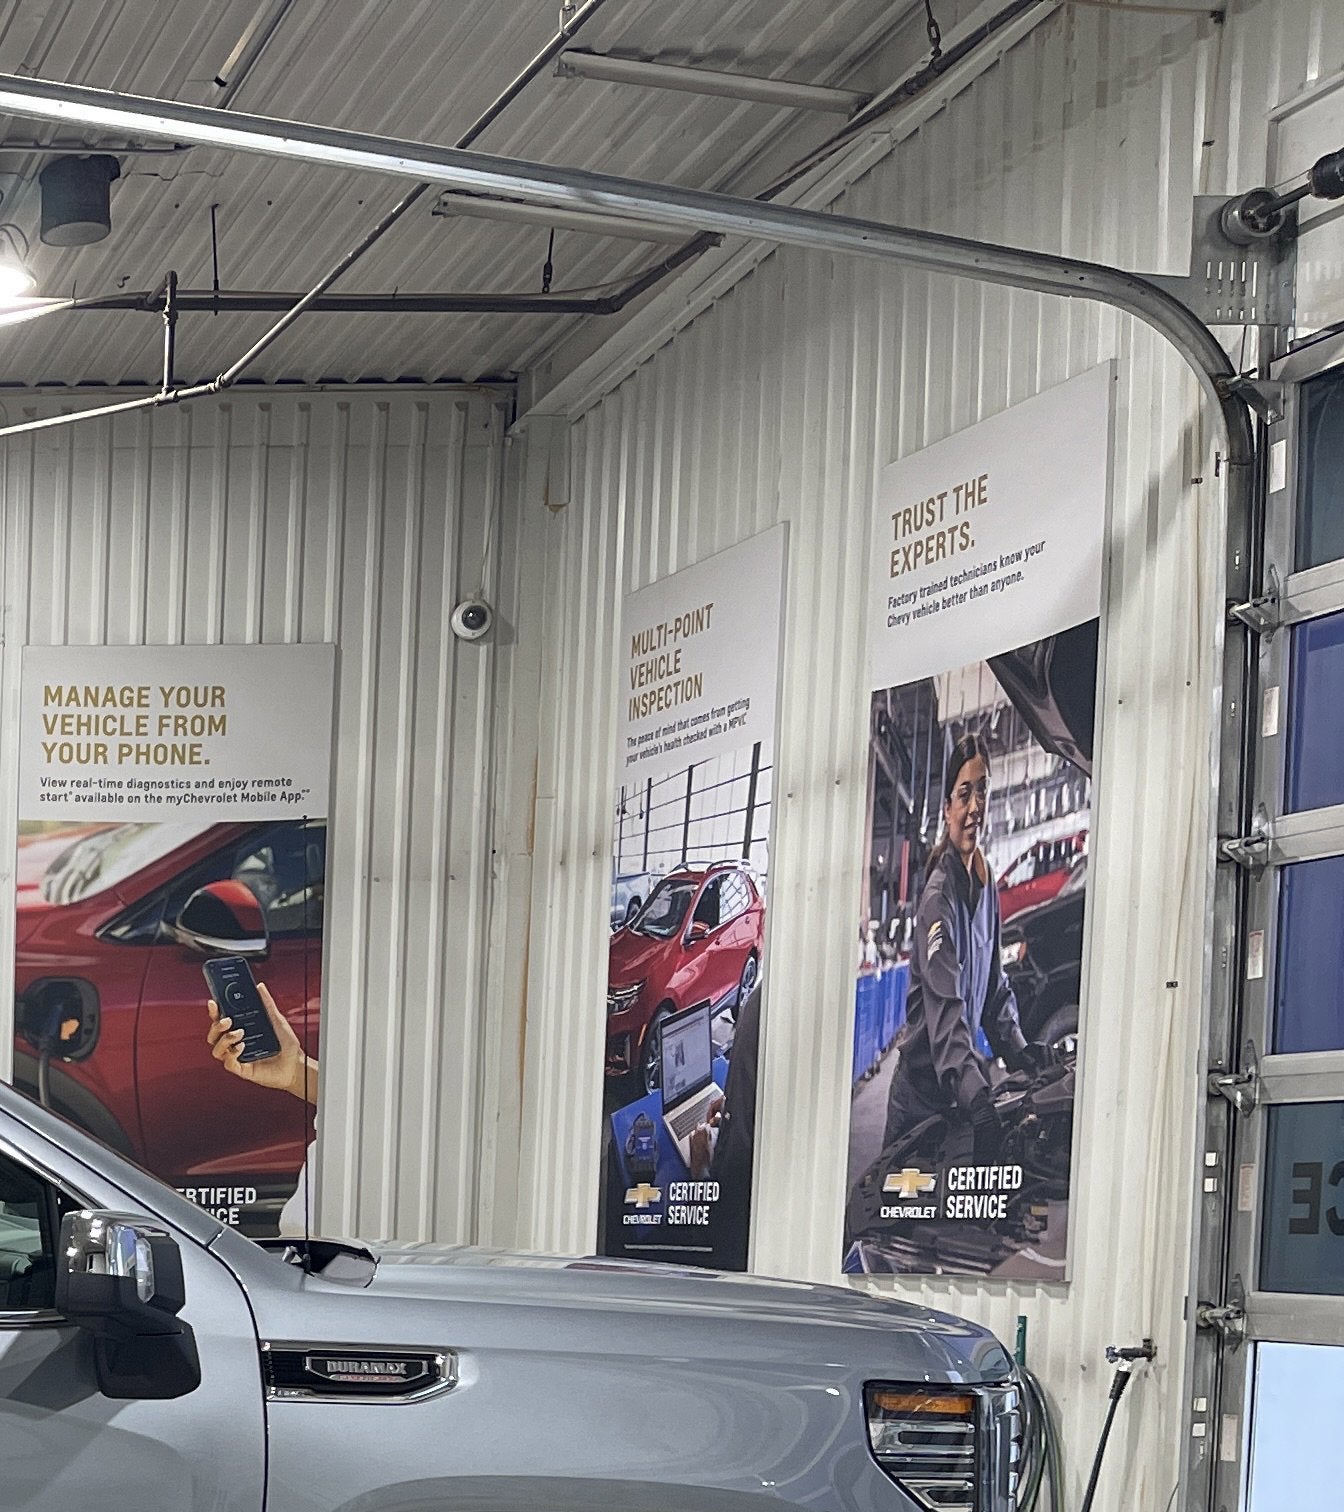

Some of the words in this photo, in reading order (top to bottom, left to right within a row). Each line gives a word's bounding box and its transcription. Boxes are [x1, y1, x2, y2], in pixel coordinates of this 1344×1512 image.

[891, 491, 948, 541] TRUST
[952, 474, 988, 516] THE
[890, 520, 975, 578] EXPERTS.
[888, 590, 918, 609] Factory
[920, 576, 948, 598] trained
[950, 560, 997, 587] technicians
[1000, 550, 1022, 568] know
[1024, 540, 1046, 562] your
[887, 612, 910, 628] Chevy
[913, 600, 940, 620] vehicle
[942, 590, 968, 610] better
[970, 584, 988, 600] than
[991, 570, 1024, 592] anyone.
[631, 602, 714, 659] MULTI-POINT
[630, 648, 682, 690] VEHICLE
[44, 685, 150, 708] MANAGE
[160, 686, 226, 708] YOUR
[628, 672, 703, 722] INSPECTION
[42, 714, 148, 736] VEHICLE
[158, 714, 226, 736] FROM
[678, 718, 690, 731] that
[711, 707, 726, 720] from
[41, 742, 108, 765] YOUR
[118, 743, 210, 766] PHONE.
[664, 736, 682, 752] health
[40, 777, 67, 787] View
[70, 778, 123, 788] real-time
[126, 778, 191, 791] diagnostics
[194, 778, 214, 788] and
[218, 778, 248, 791] enjoy
[252, 778, 292, 788] remote
[75, 792, 124, 803] available
[128, 794, 140, 803] on
[144, 794, 162, 803] the
[166, 793, 238, 806] myChevrolet
[241, 792, 276, 802] Mobile
[948, 1165, 1022, 1190] CERTIFIED
[176, 1188, 256, 1204] RTIFIED
[669, 1182, 720, 1202] CERTIFIED
[668, 1206, 710, 1225] SERVICE
[880, 1206, 937, 1218] CHEVROLET
[946, 1194, 1008, 1218] SERVICE
[623, 1214, 662, 1225] CHEVROLET
[327, 1360, 407, 1374] DURAMAX
